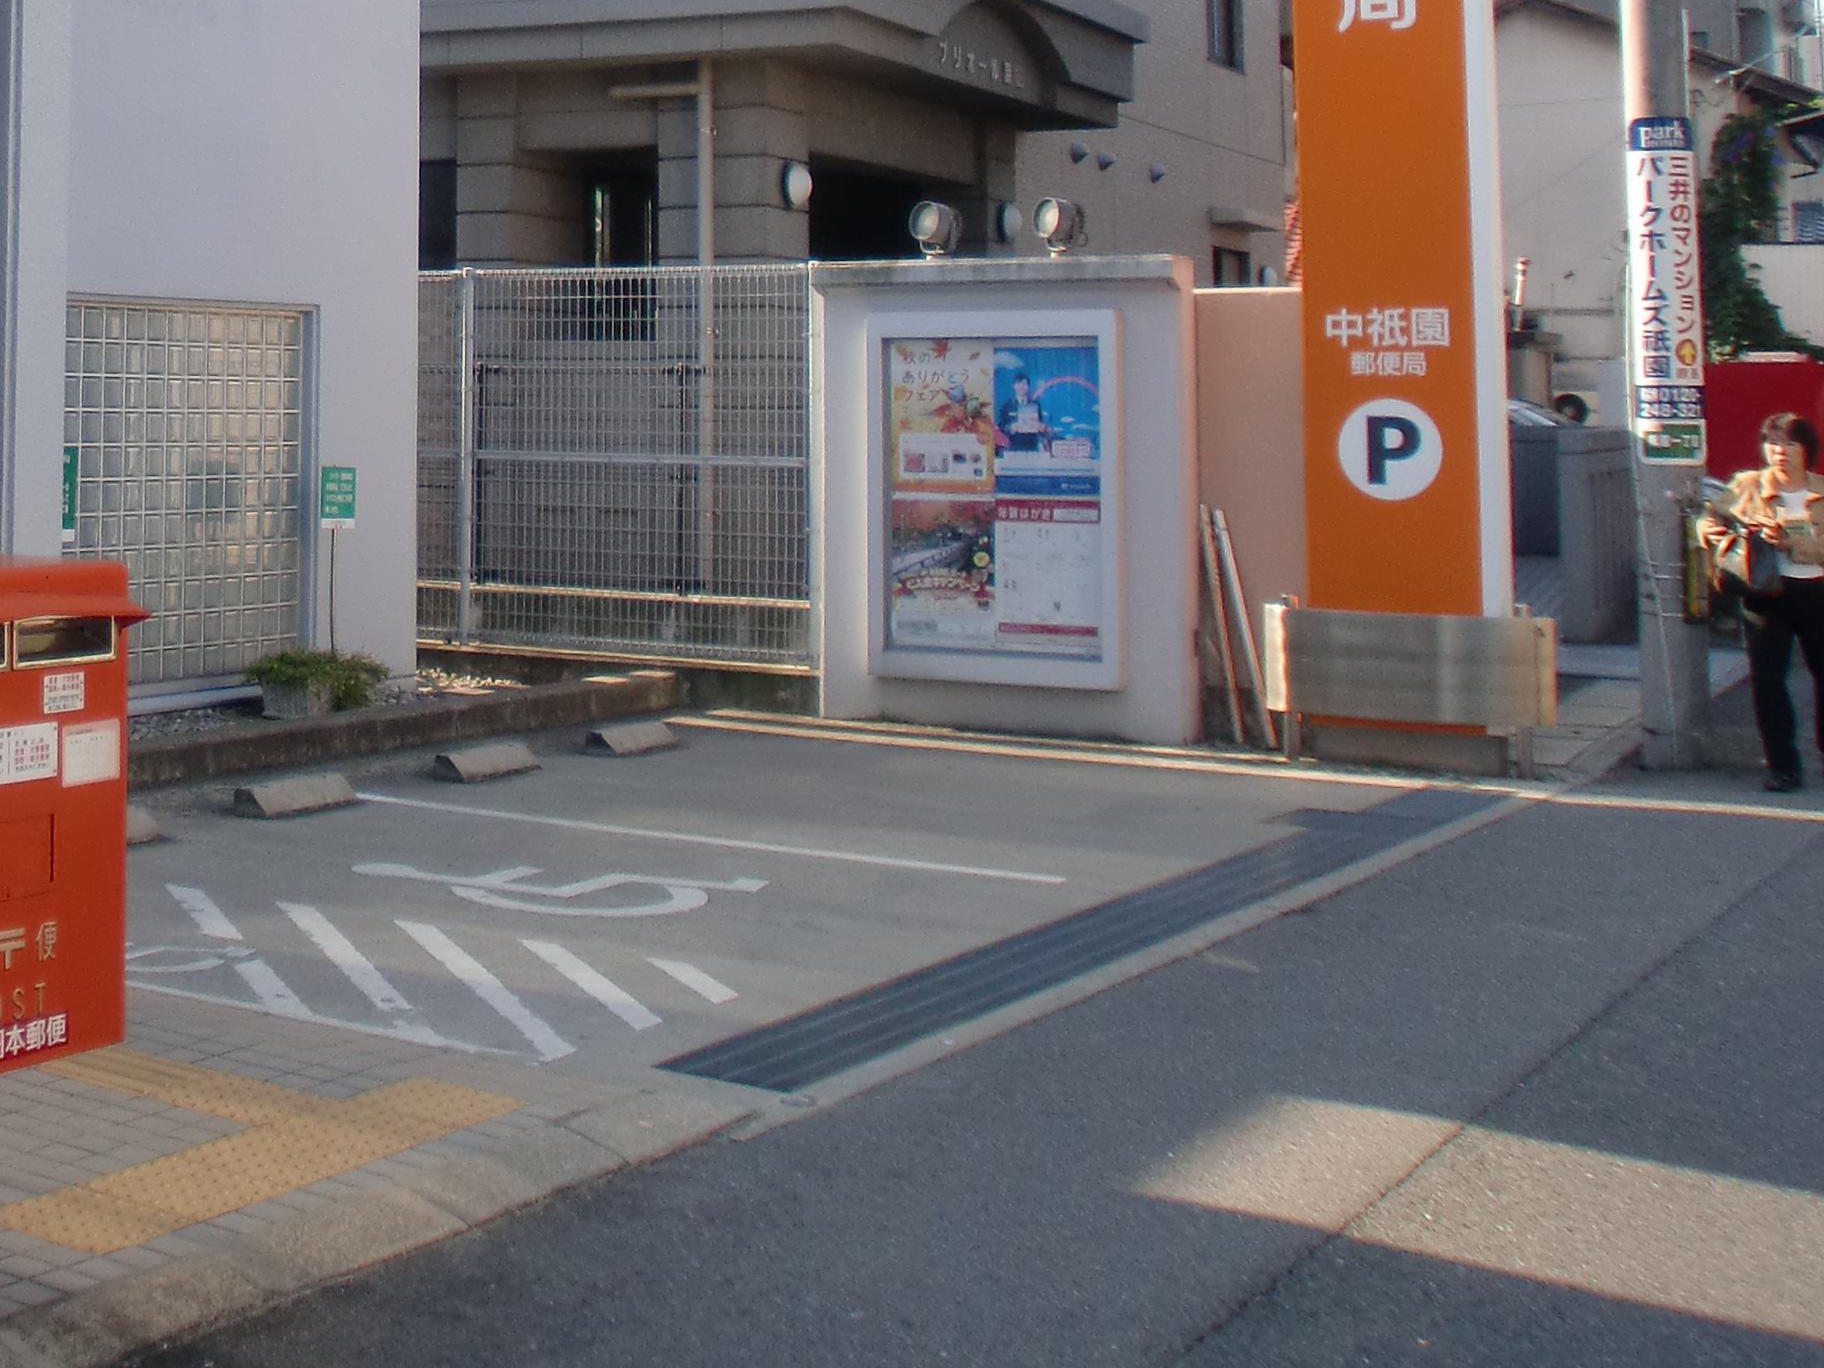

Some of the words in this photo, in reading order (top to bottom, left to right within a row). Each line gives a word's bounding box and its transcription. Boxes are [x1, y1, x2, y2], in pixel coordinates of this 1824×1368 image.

[1638, 120, 1684, 148] park
[1668, 156, 1696, 334] 三井のマンション
[1324, 306, 1450, 348] 中祇園
[902, 369, 970, 384] ありがとう
[1349, 351, 1427, 378] 郵便局
[903, 390, 940, 402] フェア
[1366, 415, 1422, 486] P
